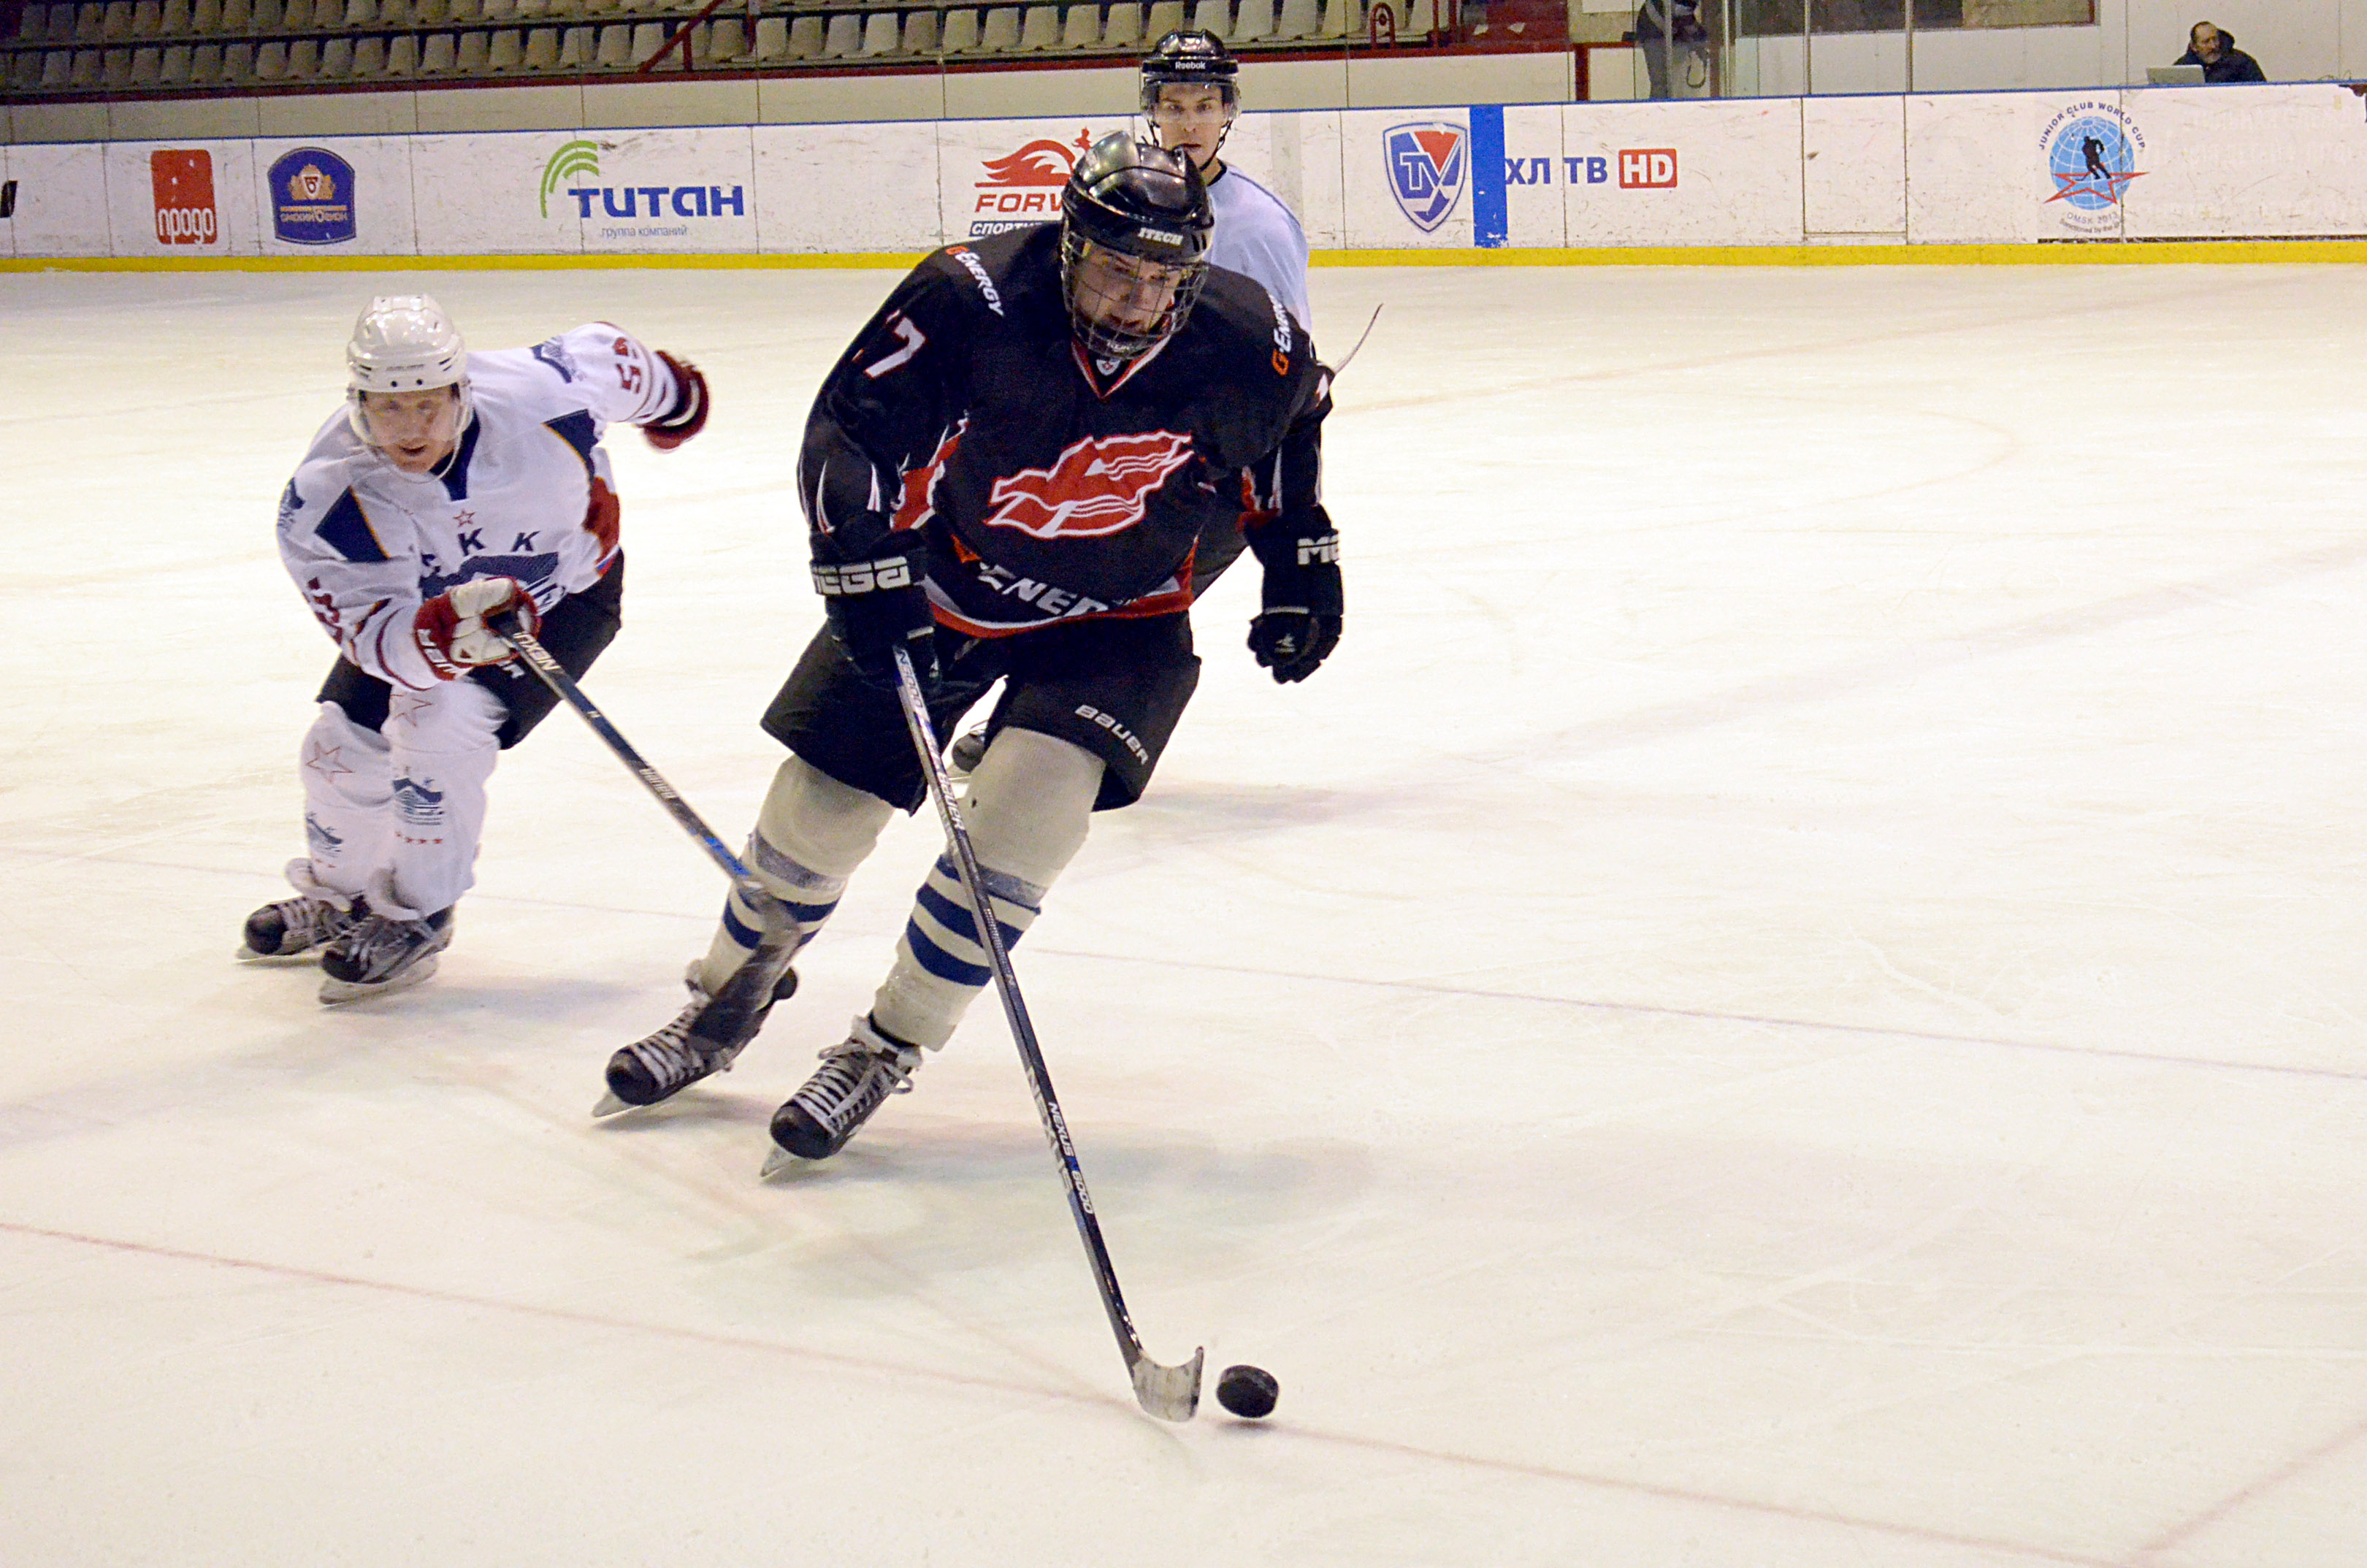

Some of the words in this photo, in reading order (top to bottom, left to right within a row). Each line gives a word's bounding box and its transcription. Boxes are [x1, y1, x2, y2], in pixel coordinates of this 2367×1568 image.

[1175, 61, 1205, 70] Reebok
[2038, 112, 2065, 150] JUNIOR
[2066, 102, 2094, 115] CLUB
[2098, 102, 2132, 125] WORLD
[2132, 126, 2146, 149] CUP
[1505, 157, 1551, 185] ХЛ
[1564, 156, 1608, 184] ТВ
[1623, 153, 1675, 184] HD
[602, 227, 636, 239] группа
[638, 224, 688, 237] компаний
[1048, 1101, 1075, 1157] NEXUS
